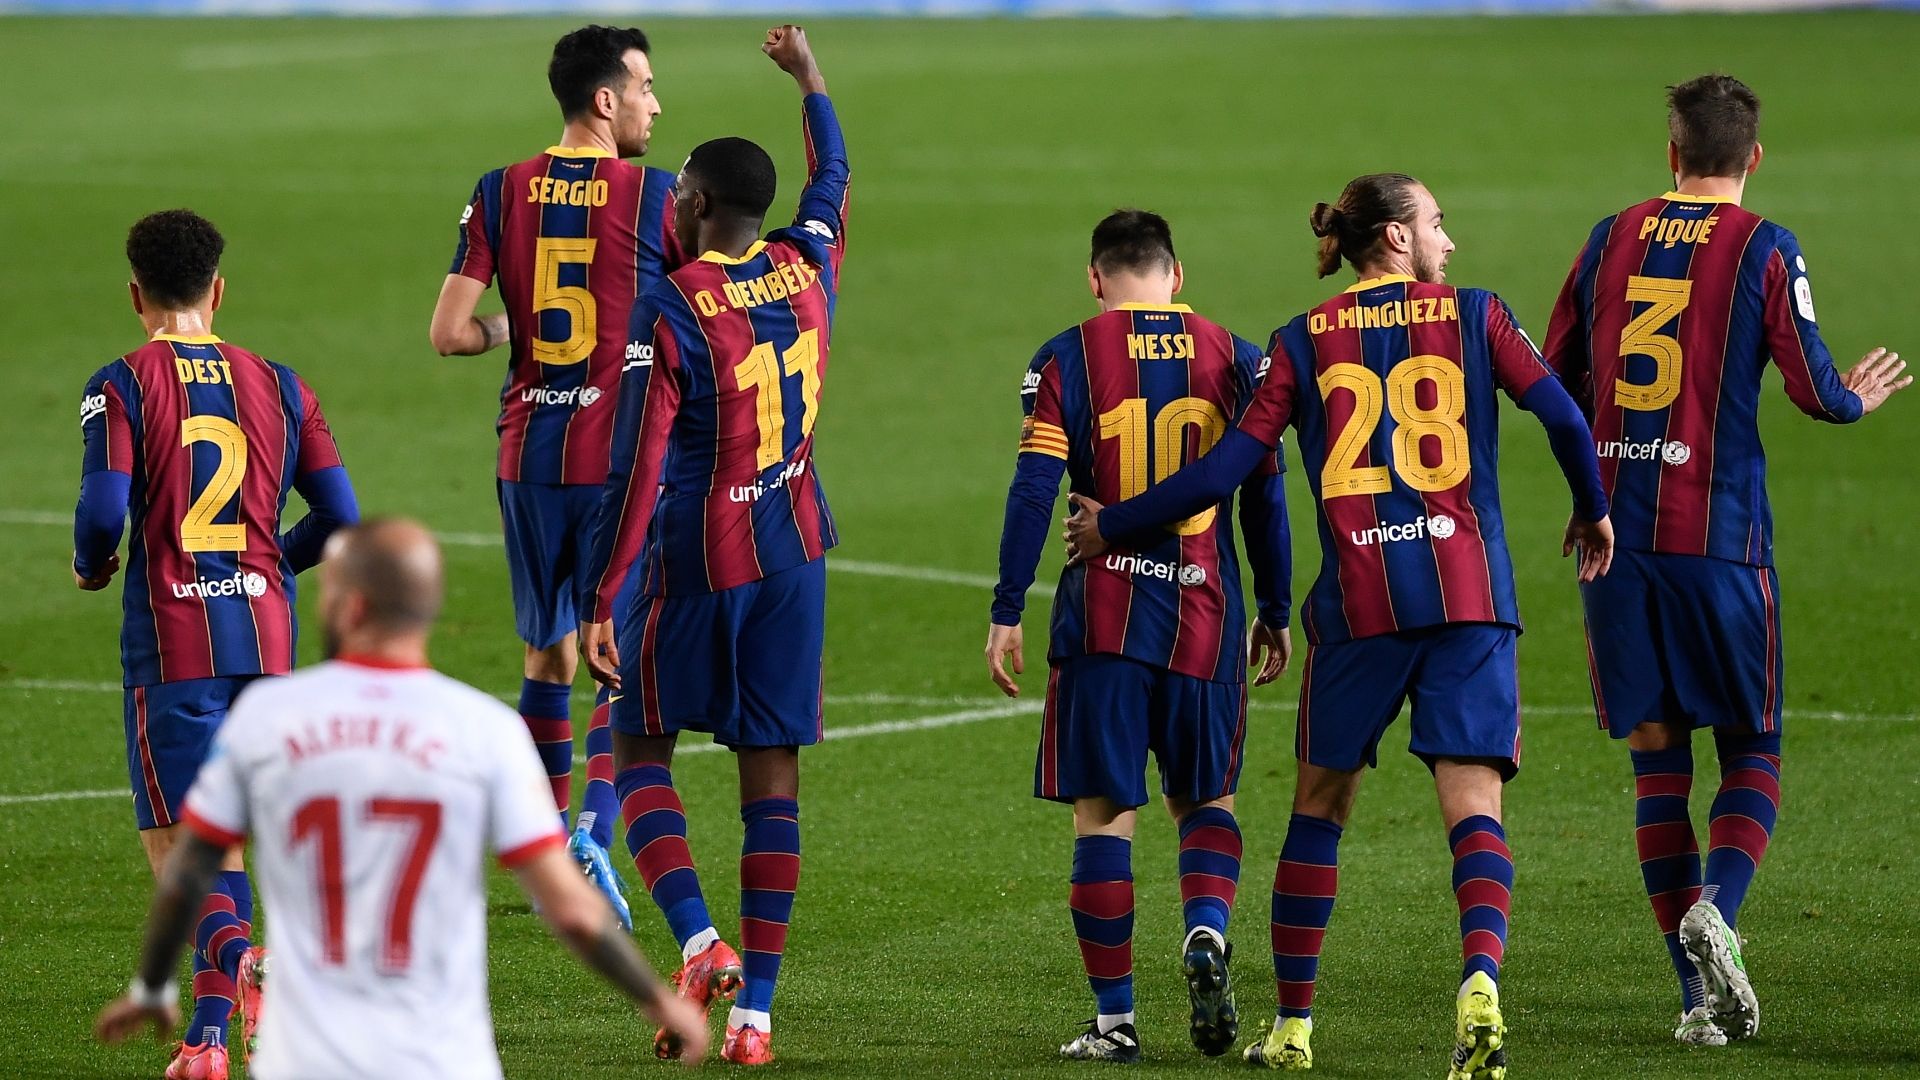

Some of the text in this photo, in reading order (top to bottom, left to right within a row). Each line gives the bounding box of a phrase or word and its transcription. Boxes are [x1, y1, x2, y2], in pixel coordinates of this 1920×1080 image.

[528, 177, 608, 207] SERGIO
[1639, 216, 1720, 249] PIQUÉ
[532, 237, 598, 366] 5
[694, 289, 728, 317] O.
[1310, 297, 1457, 335] O. MINGUEZA
[1127, 334, 1196, 360] MESSI
[1614, 275, 1694, 412] 3
[175, 358, 232, 384] DEST
[521, 386, 579, 406] unicef
[734, 327, 823, 471] 11
[1316, 355, 1471, 500] 28
[1596, 437, 1661, 460] unicef
[1099, 397, 1229, 536] 10
[181, 415, 247, 552] 2
[1351, 516, 1425, 546] unicef
[1105, 553, 1177, 582] unicef
[172, 572, 244, 599] unicef
[285, 794, 443, 975] 17
